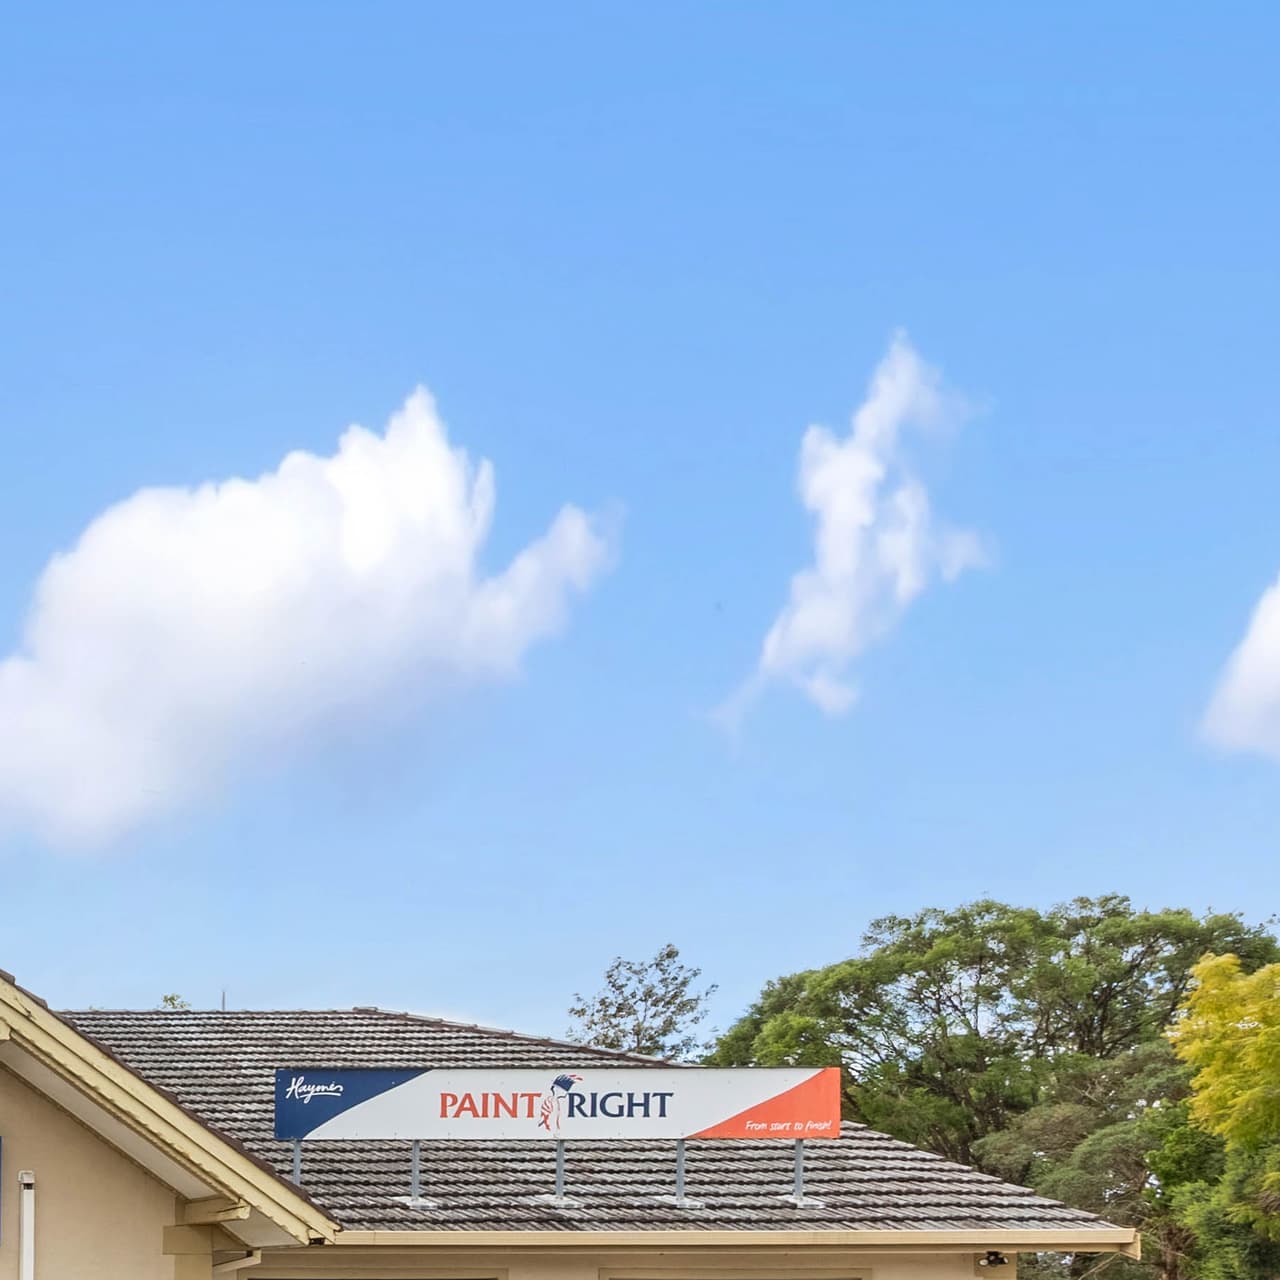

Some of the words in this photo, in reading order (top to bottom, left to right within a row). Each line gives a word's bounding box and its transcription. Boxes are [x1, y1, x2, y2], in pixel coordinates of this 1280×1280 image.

[285, 1075, 344, 1104] Haymes
[439, 1093, 541, 1118] PAINT
[567, 1092, 674, 1118] RIGHT
[745, 1120, 767, 1130] From
[769, 1121, 792, 1131] start
[794, 1121, 804, 1130] to
